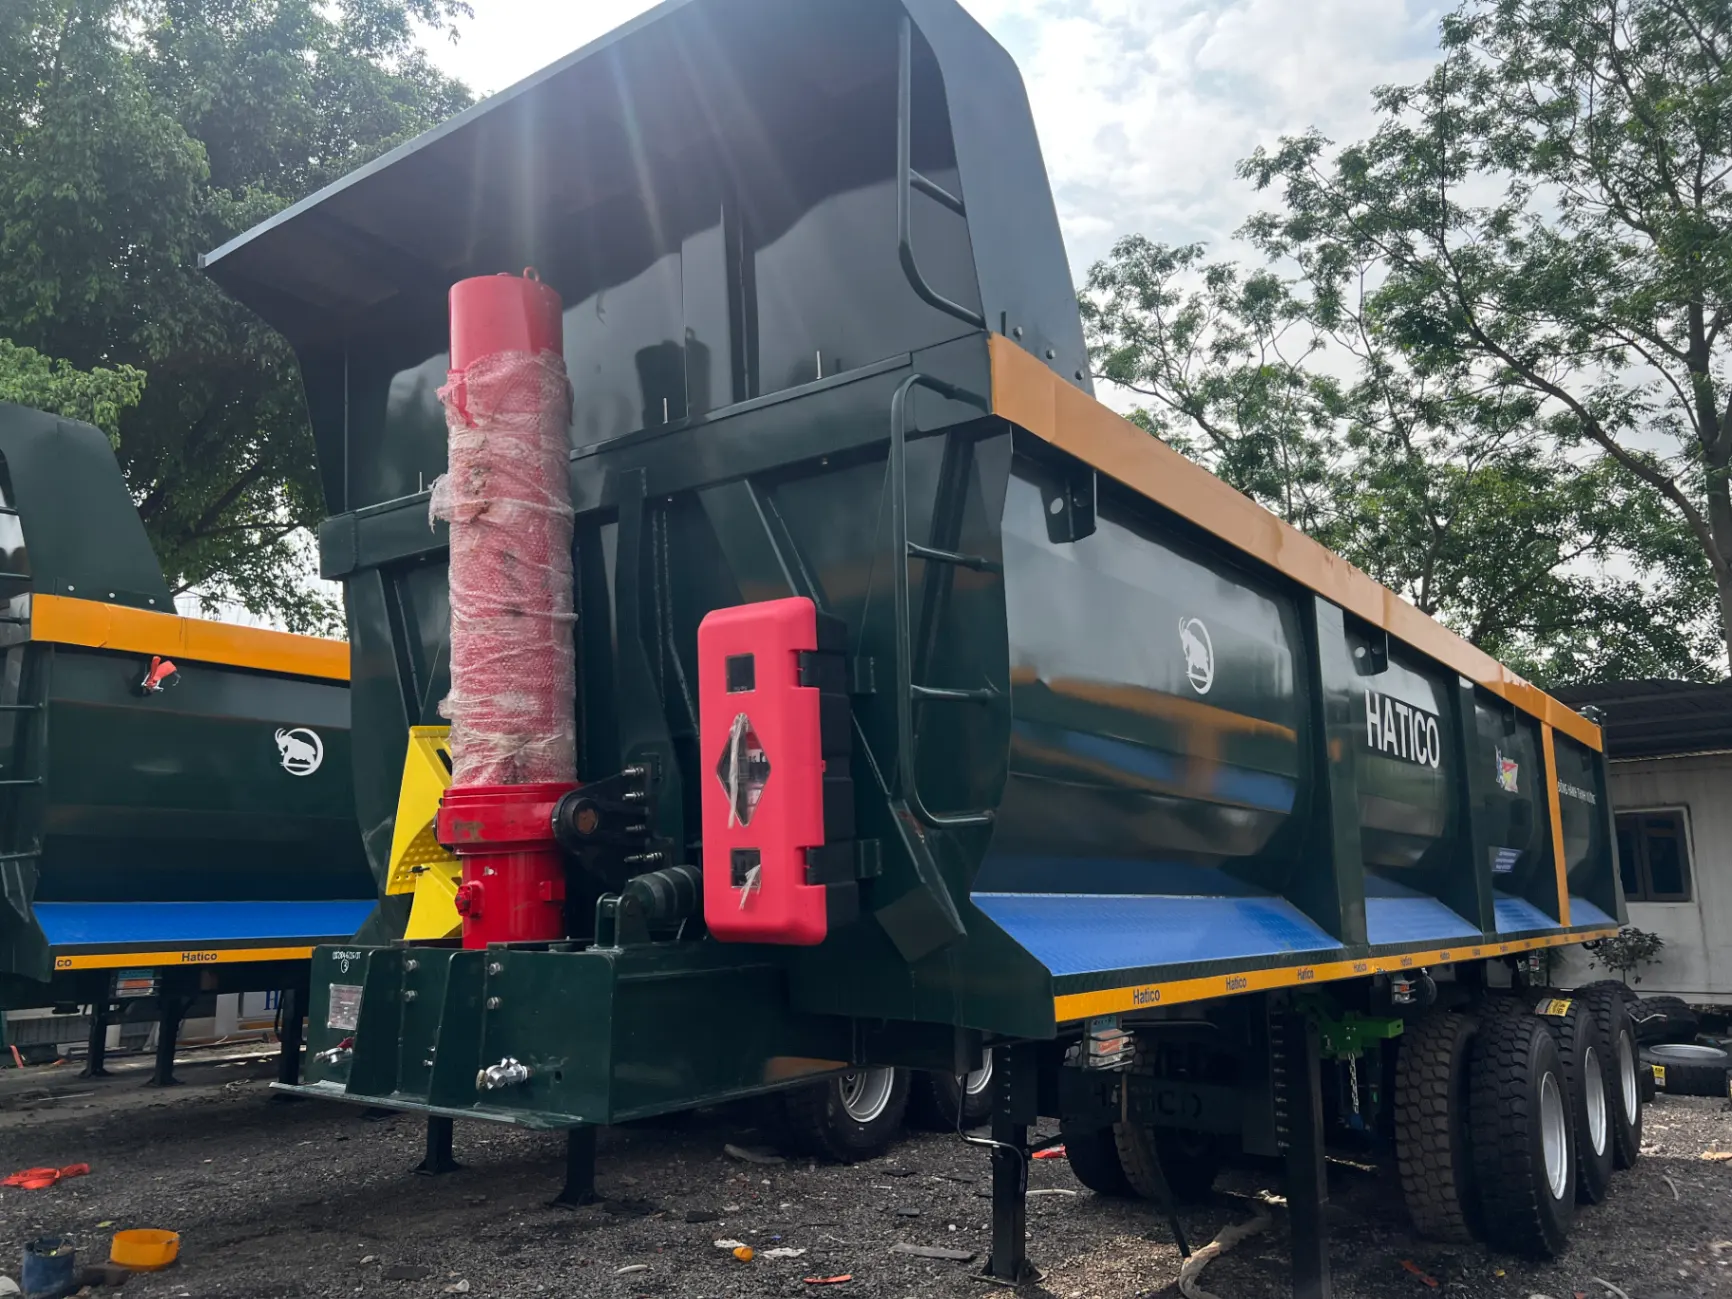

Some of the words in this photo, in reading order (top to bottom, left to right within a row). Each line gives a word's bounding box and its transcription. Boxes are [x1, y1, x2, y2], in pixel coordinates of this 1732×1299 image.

[1365, 689, 1440, 769] HATICO
[181, 952, 218, 963] Hatico
[1297, 968, 1314, 981] Hatico
[1226, 976, 1247, 991] Hatico
[1133, 988, 1161, 1005] Hatico
